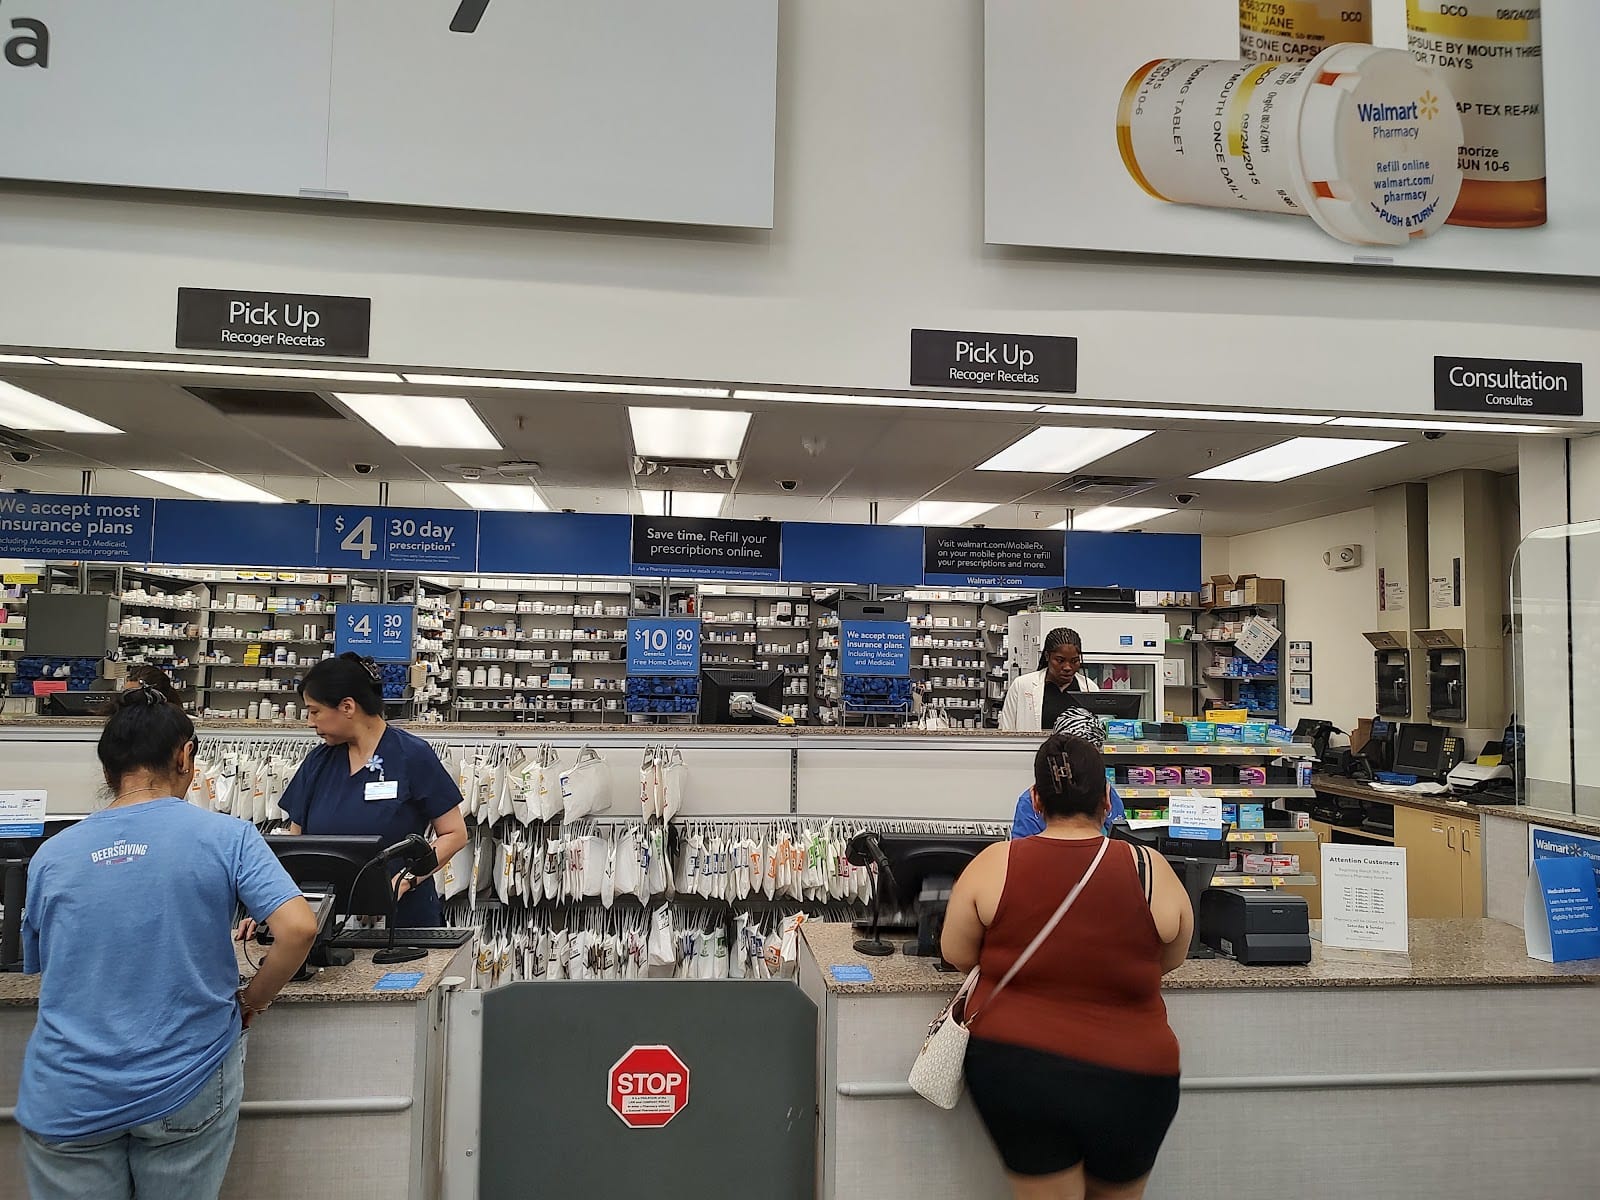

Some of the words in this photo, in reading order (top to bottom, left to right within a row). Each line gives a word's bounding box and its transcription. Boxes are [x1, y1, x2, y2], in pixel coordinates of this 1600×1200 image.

[1441, 4, 1468, 17] DCO
[1265, 16, 1294, 29] JANE
[1256, 37, 1280, 52] ONE
[1446, 42, 1465, 55] BY
[1467, 45, 1513, 58] MOUTH
[1430, 54, 1436, 65] 7
[1439, 55, 1473, 70] DAYS
[1214, 73, 1241, 117] MOUTH
[1357, 101, 1419, 122] Walmart
[1475, 104, 1500, 116] TEX
[1172, 98, 1185, 155] TABLET
[1373, 126, 1420, 140] Pharmacy
[1212, 119, 1226, 163] ONCE
[1377, 161, 1400, 174] Refill
[1403, 160, 1430, 172] online
[1484, 161, 1510, 172] 10-6
[1220, 166, 1248, 201] DAILY
[1384, 190, 1428, 205] pharmacy
[1380, 208, 1404, 227] PUSH
[1406, 216, 1412, 228] &
[1412, 203, 1435, 226] TURN
[228, 300, 278, 325] Pick
[284, 303, 320, 334] Up
[221, 329, 275, 347] Recoger
[276, 332, 326, 347] Recetas
[955, 341, 998, 364] Pick
[1003, 343, 1034, 371] Up
[949, 367, 995, 384] Recoger
[998, 370, 1040, 384] Recetas
[1449, 366, 1568, 391] Consultation
[1485, 393, 1534, 407] Consultas
[0, 498, 26, 514] We
[31, 502, 91, 520] accept
[96, 504, 141, 518] most
[88, 518, 134, 538] plans
[390, 519, 417, 537] 30
[420, 521, 455, 543] day
[30, 538, 64, 547] Medicare
[65, 538, 82, 547] Part
[92, 540, 128, 549] Medicaid,
[647, 528, 674, 540] Save
[677, 530, 707, 542] time.
[710, 531, 739, 543] Refill
[742, 534, 768, 546] your
[650, 544, 724, 558] prescriptions
[726, 546, 764, 558] online.
[937, 539, 955, 549] Visit
[957, 540, 1045, 551] walmart.com/MobileRx
[42, 547, 93, 556] compensation
[94, 548, 131, 558] programs.
[950, 550, 966, 559] your
[969, 549, 996, 558] mobile
[997, 551, 1021, 561] phone
[1023, 551, 1032, 559] to
[1034, 551, 1052, 560] refill
[937, 560, 956, 569] your
[957, 559, 1007, 570] prescriptions
[1008, 560, 1021, 569] and
[1023, 562, 1047, 570] more.
[967, 576, 997, 585] Walmart
[383, 614, 403, 628] 30
[383, 627, 402, 640] day
[676, 628, 694, 642] 90
[847, 631, 860, 639] We
[861, 633, 886, 642] accept
[887, 633, 906, 641] most
[675, 642, 693, 653] day
[884, 641, 905, 651] plans.
[876, 651, 904, 659] Medicare
[633, 658, 648, 666] Free
[668, 659, 693, 668] Delivery
[91, 843, 149, 863] BEERSGIVING
[1536, 838, 1570, 856] Walmart
[1329, 856, 1362, 864] Attention
[1363, 858, 1400, 867] Customers
[617, 1072, 683, 1095] STOP
